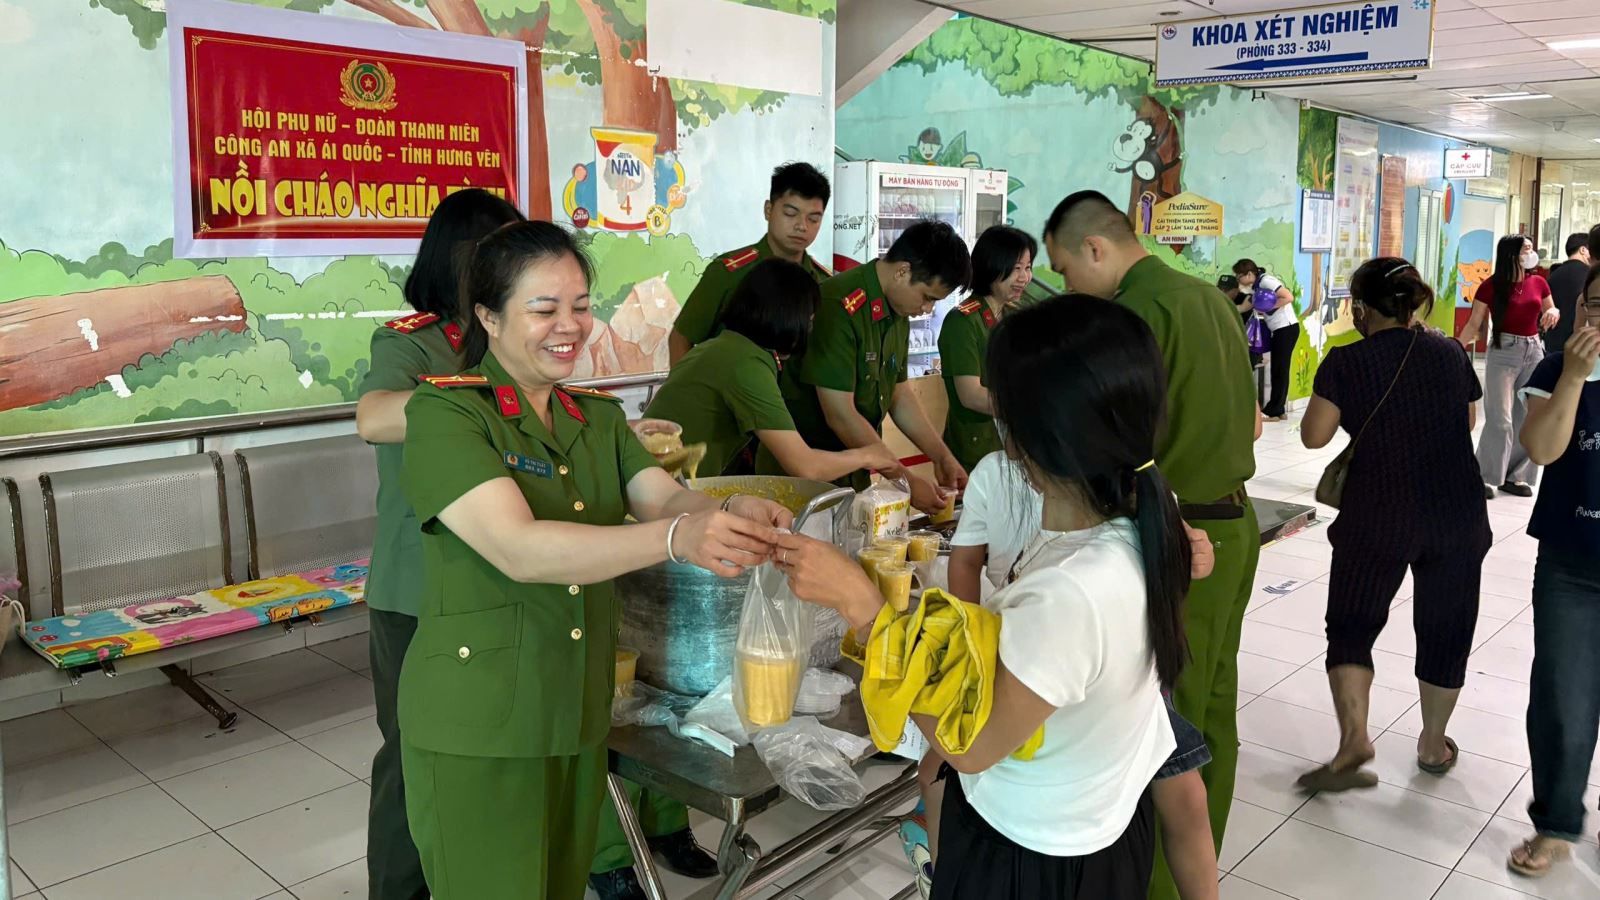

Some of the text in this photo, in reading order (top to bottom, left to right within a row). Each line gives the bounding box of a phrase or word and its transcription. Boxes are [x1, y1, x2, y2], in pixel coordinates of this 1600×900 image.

[1192, 3, 1399, 47] KHOA XÉT NGHIỆM
[1236, 43, 1275, 60] (PHÒNG
[1277, 43, 1297, 56] 333
[1306, 39, 1331, 53] 334)
[241, 106, 271, 132] HỘI
[277, 111, 309, 135] PHỤ
[315, 112, 337, 133] NỮ
[355, 116, 396, 137] ĐOÀN
[400, 121, 445, 140] THANH
[450, 123, 480, 143] NIÊN
[214, 133, 263, 157] CÔNG
[268, 139, 291, 158] AN
[296, 138, 317, 159] XÃ
[321, 139, 337, 160] ÁI
[342, 139, 383, 162] QUỐC
[400, 143, 432, 165] TỈNH
[437, 148, 473, 167] HƯNG
[476, 149, 501, 168] YÊN
[611, 158, 641, 176] NAN
[209, 159, 267, 217] NỒI
[273, 171, 355, 218] CHÁO
[358, 176, 441, 219] NGHĨA
